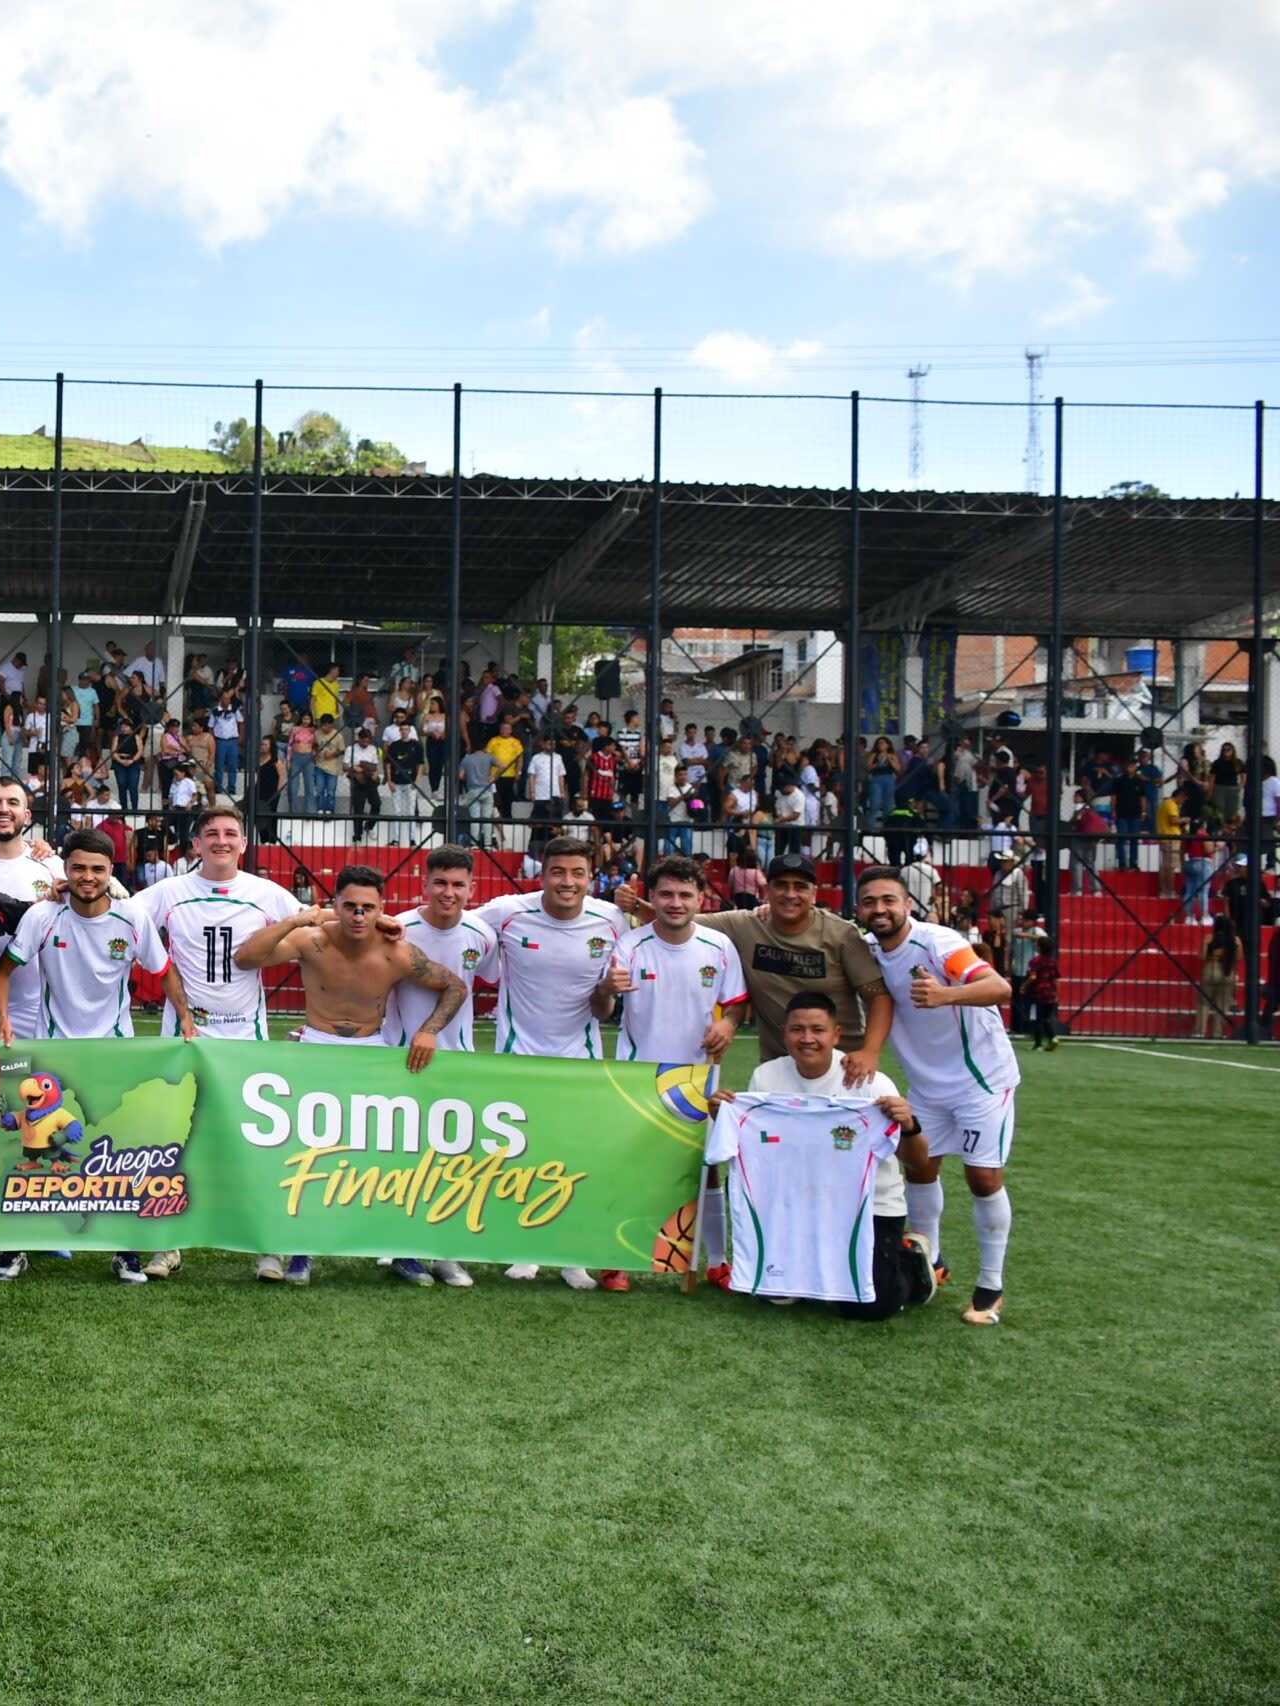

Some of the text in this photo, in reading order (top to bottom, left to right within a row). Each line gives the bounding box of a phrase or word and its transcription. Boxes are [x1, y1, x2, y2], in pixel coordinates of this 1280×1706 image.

[203, 926, 232, 983] 11
[223, 1016, 246, 1024] Neira
[0, 1061, 28, 1072] CALDAS
[240, 1072, 529, 1158] Somos
[963, 1129, 981, 1153] 27
[84, 1139, 178, 1188] Juegos
[4, 1174, 185, 1199] DEPORTIVOS
[279, 1145, 587, 1232] Finalistas
[2, 1200, 140, 1212] DEPARTAMENTALES
